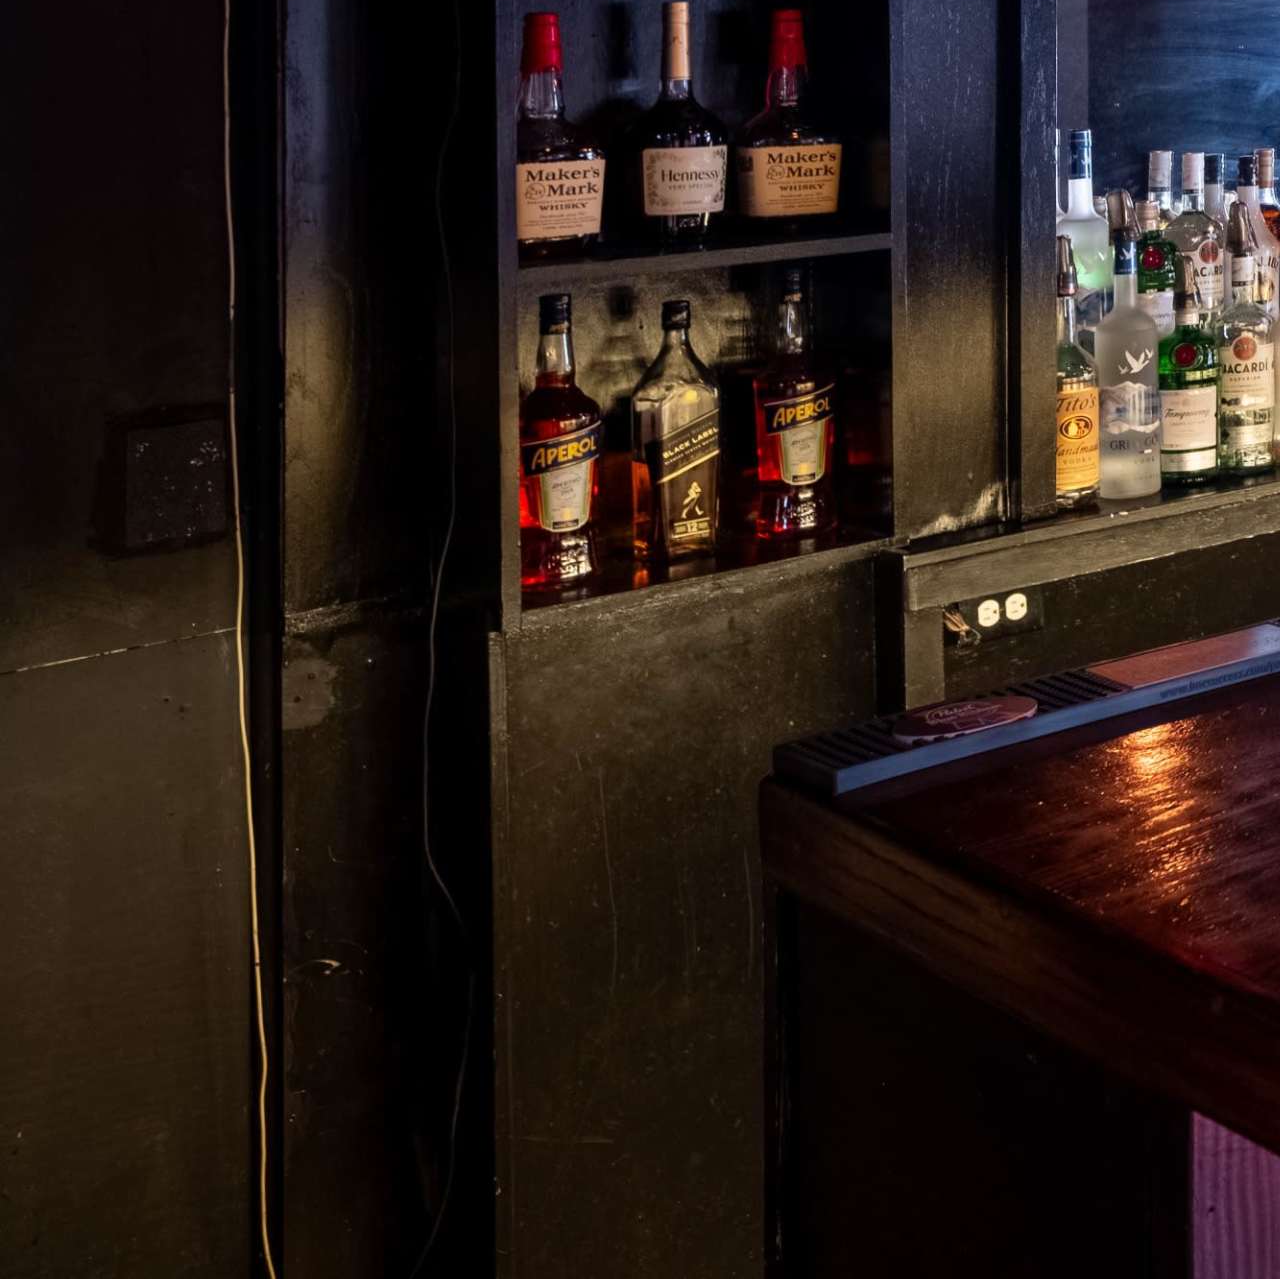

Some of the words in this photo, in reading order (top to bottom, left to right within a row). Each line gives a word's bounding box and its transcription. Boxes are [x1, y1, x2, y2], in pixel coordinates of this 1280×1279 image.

[767, 150, 837, 165] Maker's
[524, 165, 600, 182] Maker's
[661, 169, 720, 184] Hennessy
[786, 164, 835, 178] Mark
[547, 182, 599, 197] Mark
[779, 183, 825, 192] WHISKY
[539, 201, 589, 212] WHISKY
[1056, 393, 1096, 412] Tito's
[773, 396, 831, 428] APEROL
[662, 439, 690, 459] BLACK
[692, 426, 719, 444] LABEL
[531, 435, 597, 471] APEROL
[687, 522, 698, 533] 12
